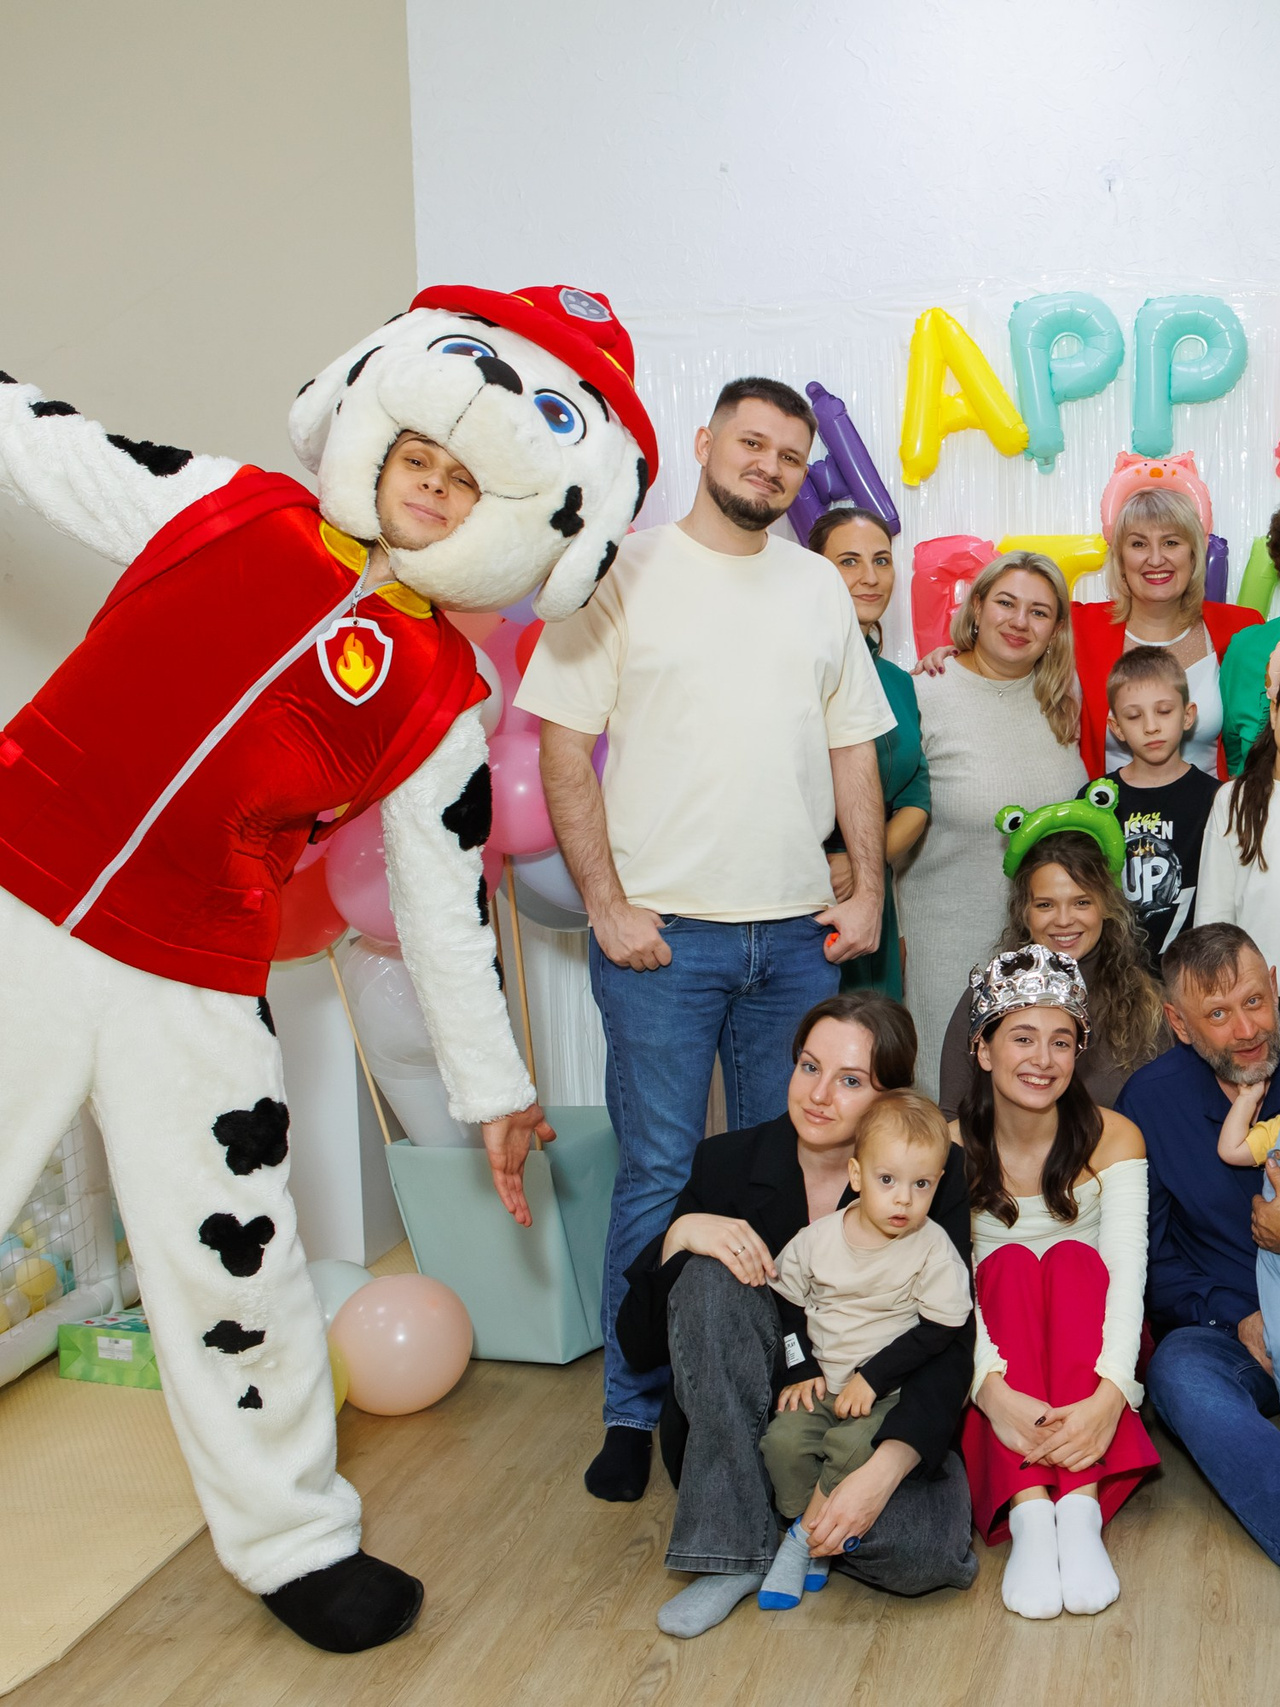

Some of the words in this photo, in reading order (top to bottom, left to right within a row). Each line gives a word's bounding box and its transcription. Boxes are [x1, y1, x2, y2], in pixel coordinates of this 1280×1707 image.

[1123, 820, 1174, 840] ISTEN
[1127, 811, 1161, 830] Hey
[1121, 856, 1170, 903] UP
